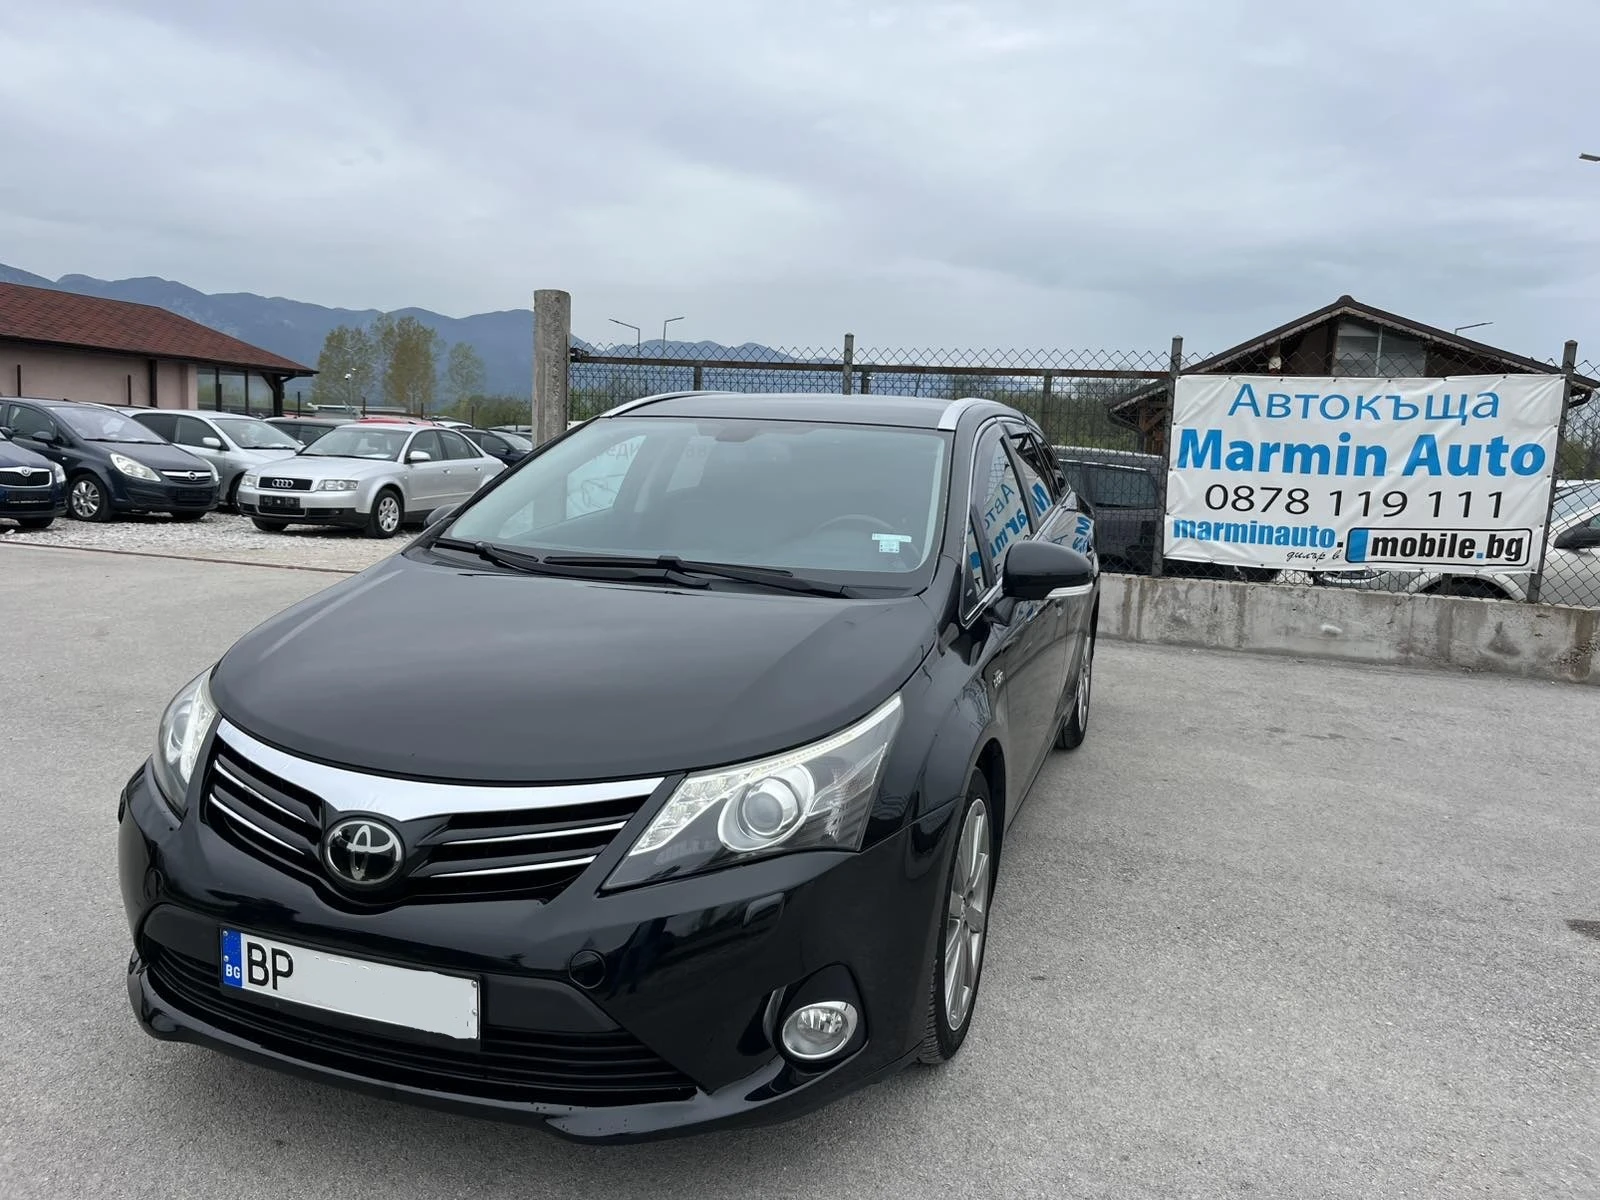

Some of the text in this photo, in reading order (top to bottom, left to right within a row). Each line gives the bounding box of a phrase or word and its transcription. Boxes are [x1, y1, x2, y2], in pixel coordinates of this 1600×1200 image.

[1228, 383, 1500, 426] Автокъща
[1176, 428, 1547, 477] Marmin Auto
[1204, 483, 1504, 518] 0878 119 111
[1370, 532, 1524, 562] mobile.bg
[225, 963, 241, 980] BG
